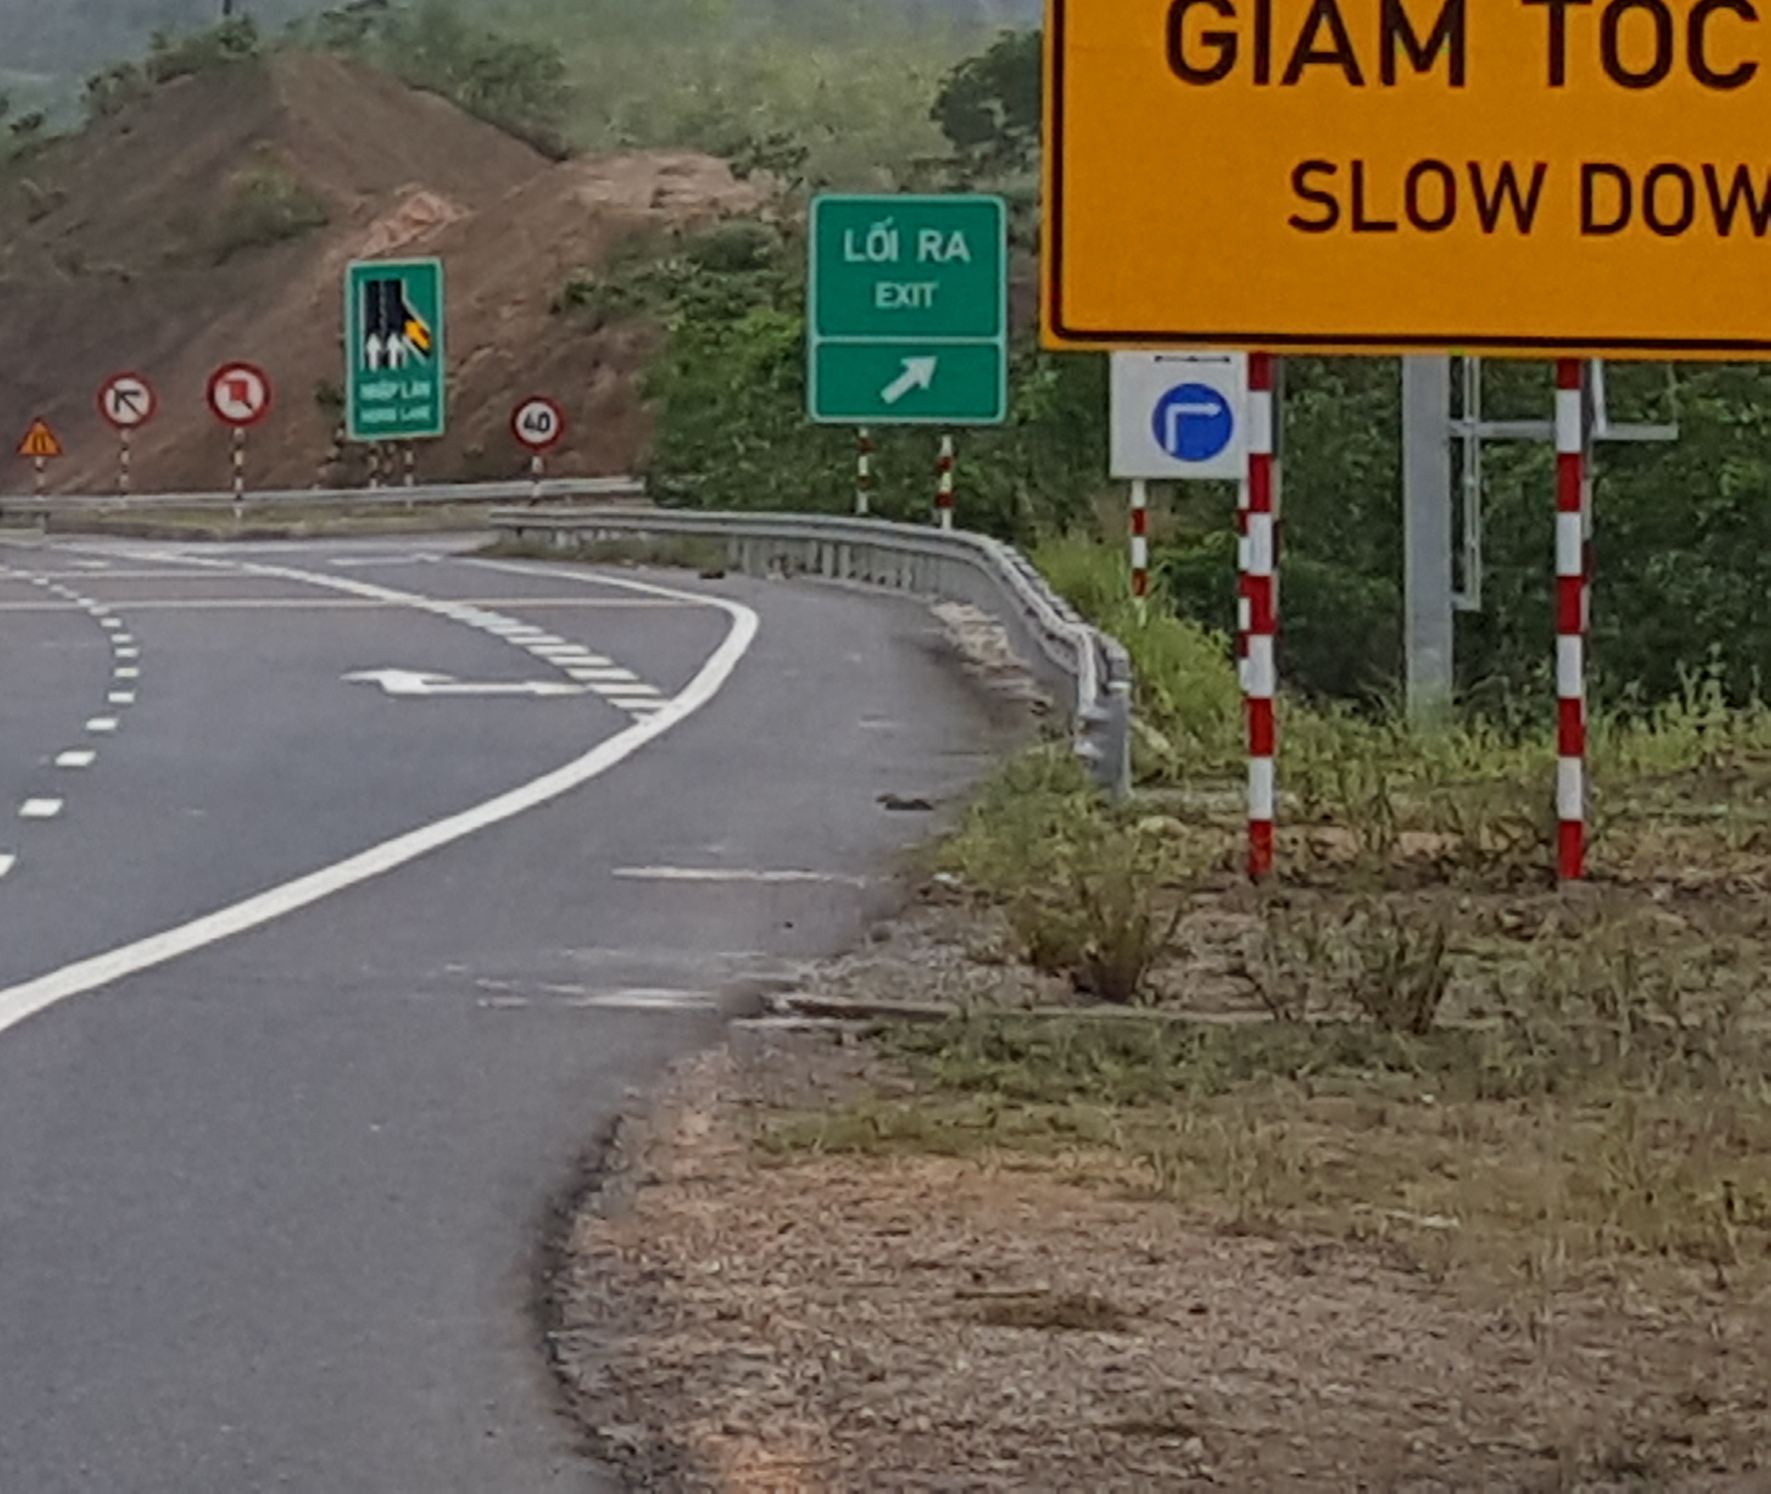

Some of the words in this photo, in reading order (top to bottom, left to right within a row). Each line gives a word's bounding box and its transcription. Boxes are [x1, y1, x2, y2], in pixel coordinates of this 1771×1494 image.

[1288, 158, 1548, 236] SLOW
[1580, 162, 1771, 238] DOW
[844, 216, 900, 263] LỐI
[917, 228, 972, 263] RA
[874, 281, 940, 310] EXIT
[523, 411, 551, 435] 40
